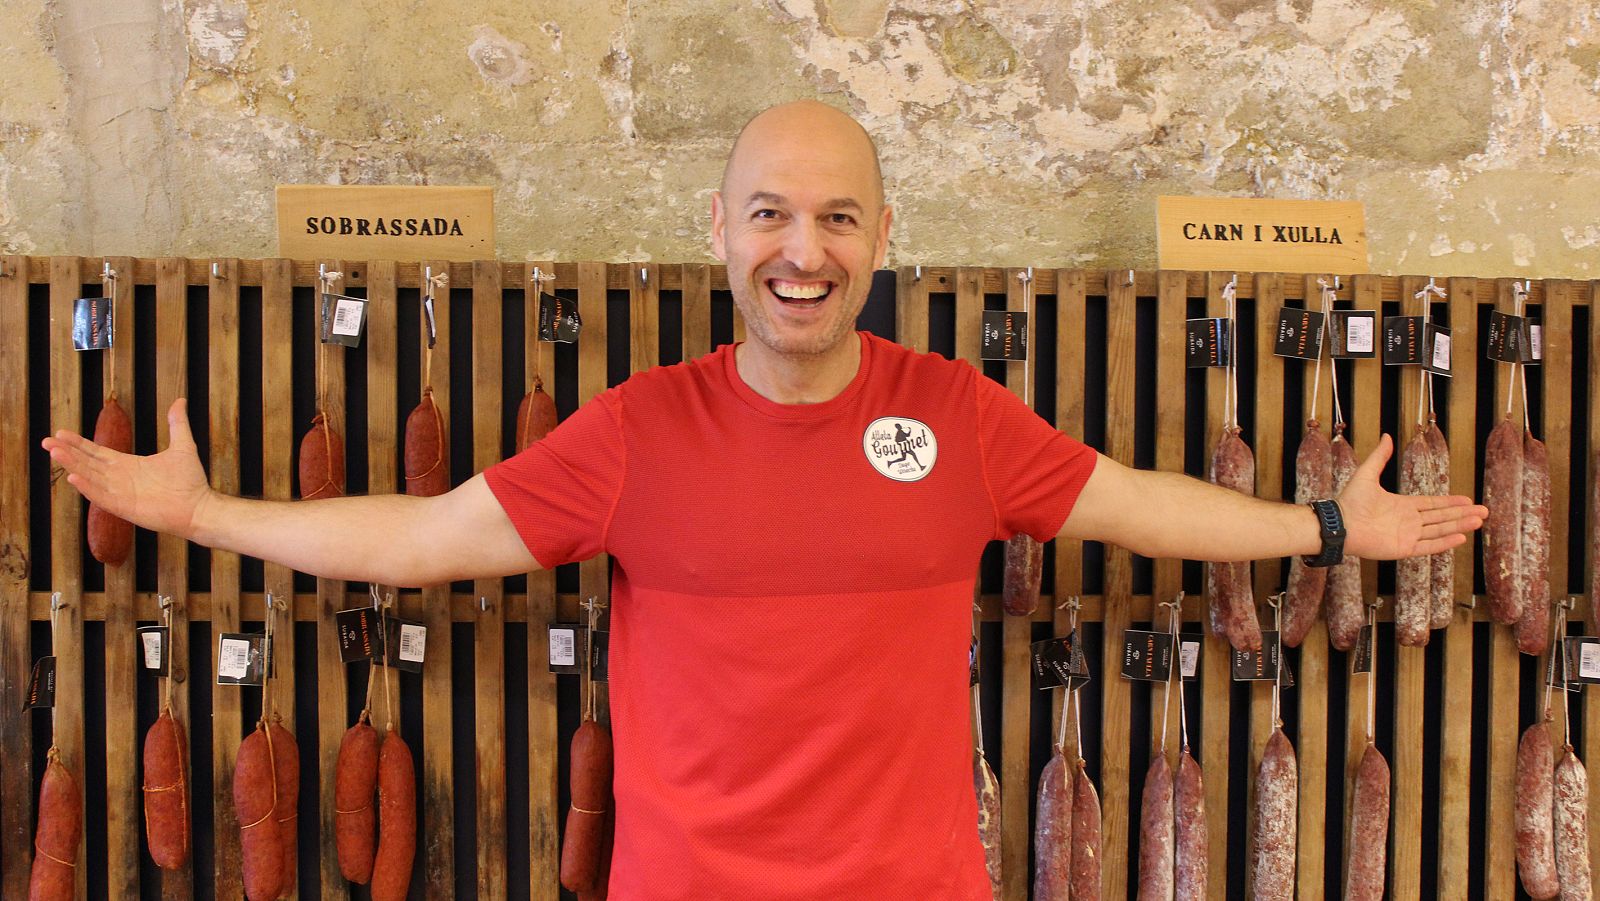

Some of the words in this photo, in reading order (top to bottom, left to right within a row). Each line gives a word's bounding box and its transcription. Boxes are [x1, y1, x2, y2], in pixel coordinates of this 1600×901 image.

[306, 216, 463, 236] SOBRASSADA
[1183, 223, 1244, 241] CARN
[1254, 225, 1262, 242] I
[1272, 225, 1342, 244] XULLA
[871, 429, 928, 458] Gourmet
[1035, 653, 1044, 676] SUBAIDA
[1052, 660, 1069, 680] SUBAIDA
